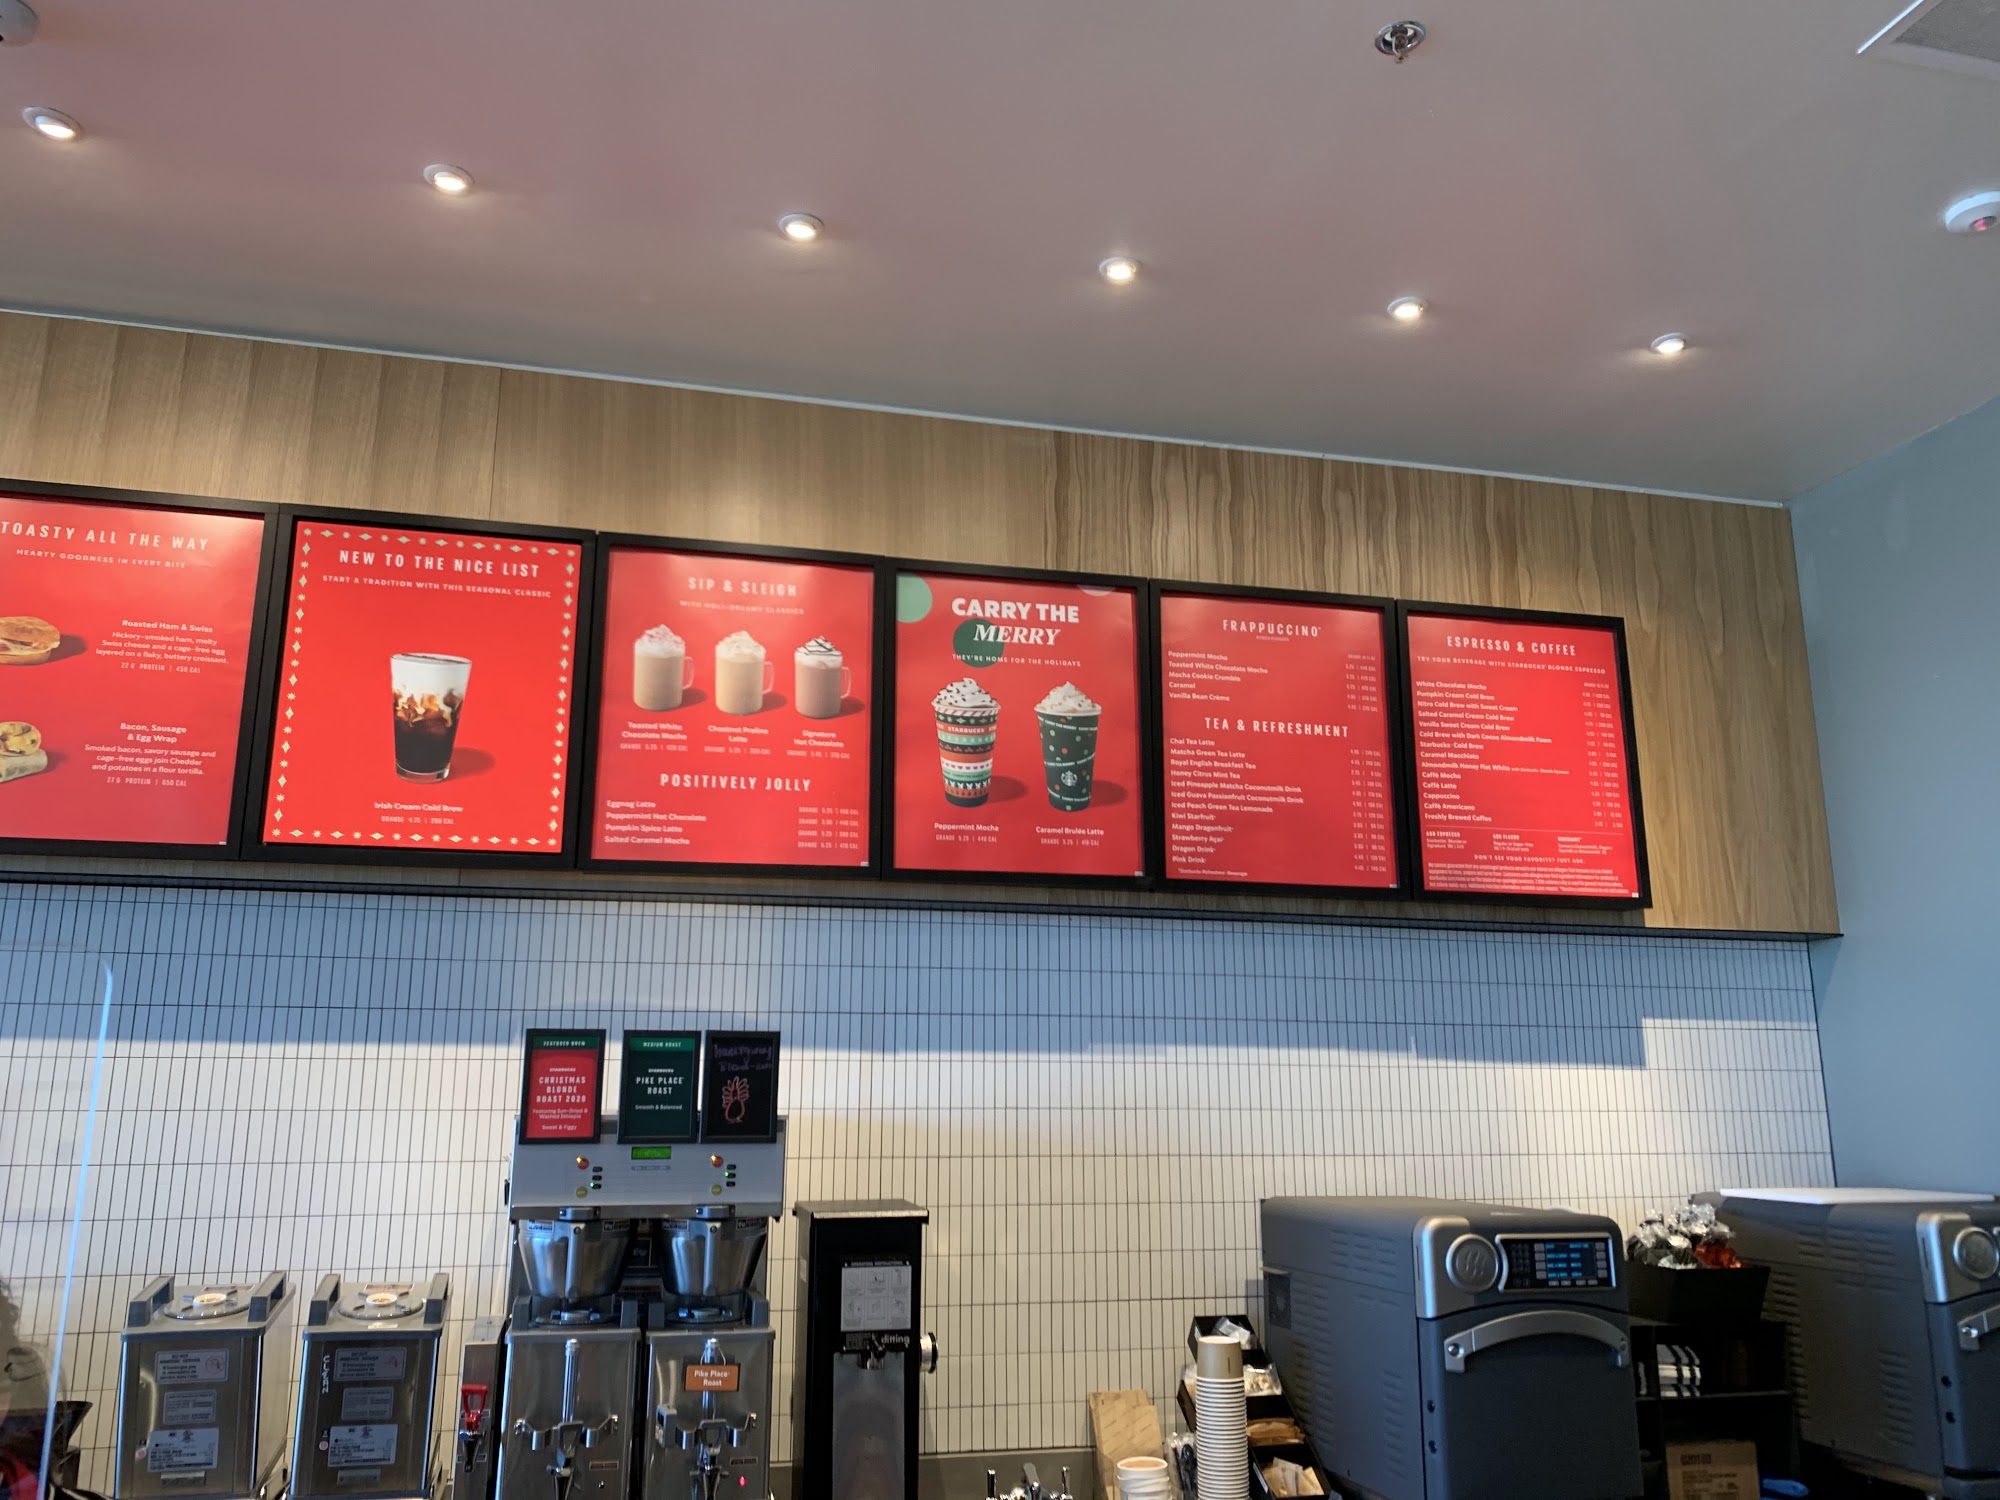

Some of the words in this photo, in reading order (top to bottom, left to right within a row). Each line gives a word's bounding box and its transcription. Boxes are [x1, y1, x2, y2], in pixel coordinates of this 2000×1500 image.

[1, 521, 76, 540] TOASTY
[85, 529, 116, 544] ALL
[129, 533, 160, 547] THE
[172, 536, 207, 549] WAY
[16, 549, 56, 558] HEARTY
[59, 553, 114, 563] GOODNESS
[339, 550, 375, 565] NEW
[385, 553, 404, 567] TO
[414, 555, 444, 570] THE
[454, 559, 493, 574] NICE
[503, 562, 539, 577] LIST
[322, 575, 350, 583] START
[363, 578, 412, 587] TRADITION
[466, 585, 511, 595] SEASONAL
[514, 589, 551, 598] CLASSIC
[688, 577, 715, 591] SIP
[723, 579, 733, 592] &
[741, 581, 797, 596] SLEIGH
[952, 598, 1032, 620] CARRY
[1035, 603, 1079, 623] THE
[122, 619, 158, 629] Roasted
[159, 622, 179, 630] Ham
[189, 624, 213, 633] Swiss
[112, 631, 175, 642] Hickory-smoked
[175, 636, 194, 644] ham,
[195, 638, 218, 646] melty
[973, 624, 1061, 645] MERRY
[101, 639, 123, 647] Swiss
[123, 641, 151, 649] cheese
[173, 646, 210, 654] cage-free
[1447, 636, 1510, 651] ESPRESSO
[1516, 641, 1525, 652] &
[1531, 642, 1576, 656] COFFEE
[96, 648, 124, 656] layered
[143, 651, 163, 660] flaky,
[164, 652, 192, 662] buttery
[192, 656, 228, 664] croissant.
[952, 653, 983, 662] THEY'RE
[1044, 659, 1081, 667] HOLIDAYS
[1168, 650, 1206, 659] Peppermint
[1206, 653, 1228, 661] Mocha
[1168, 660, 1194, 668] Toasted
[1194, 662, 1214, 670] White
[1214, 664, 1246, 672] Chocolate
[1246, 666, 1268, 674] Mocha
[1191, 672, 1214, 680] Cookie
[1214, 674, 1241, 682] Crumble
[1168, 681, 1196, 689] Caramel
[1435, 681, 1466, 689] Chocolate
[120, 722, 150, 732] Bacon,
[151, 724, 187, 734] Sausage
[1204, 717, 1229, 730] TEA
[1237, 719, 1245, 731] &
[1253, 720, 1348, 737] REFRESHMENT
[136, 734, 152, 743] Egg
[153, 735, 178, 744] Wrap
[84, 744, 116, 752] Smoked
[117, 746, 142, 754] bacon,
[144, 748, 169, 756] savory
[169, 750, 200, 758] sausage
[1447, 752, 1480, 760] Macchiato
[169, 757, 202, 766] Cheddar
[158, 766, 176, 774] flour
[660, 773, 757, 790] POSITIVELY
[765, 777, 810, 791] JOLLY
[606, 800, 635, 809] Eggnog
[606, 812, 652, 820] Peppermint
[668, 813, 707, 822] Chocolate
[605, 823, 640, 832] Pumpkin
[640, 824, 662, 833] Spice
[934, 822, 975, 831] Peppermint
[975, 824, 999, 832] Mocha
[604, 835, 630, 843] Salted
[630, 836, 663, 844] Caramel
[663, 837, 690, 845] Mocha
[539, 1076, 586, 1084] CHRISTMAS
[636, 1076, 654, 1085] PIKE
[546, 1085, 577, 1093] BLONDE
[536, 1095, 562, 1103] ROAST
[565, 1095, 586, 1103] 2020
[881, 1334, 910, 1346] ditting
[703, 1378, 722, 1386] Roast
